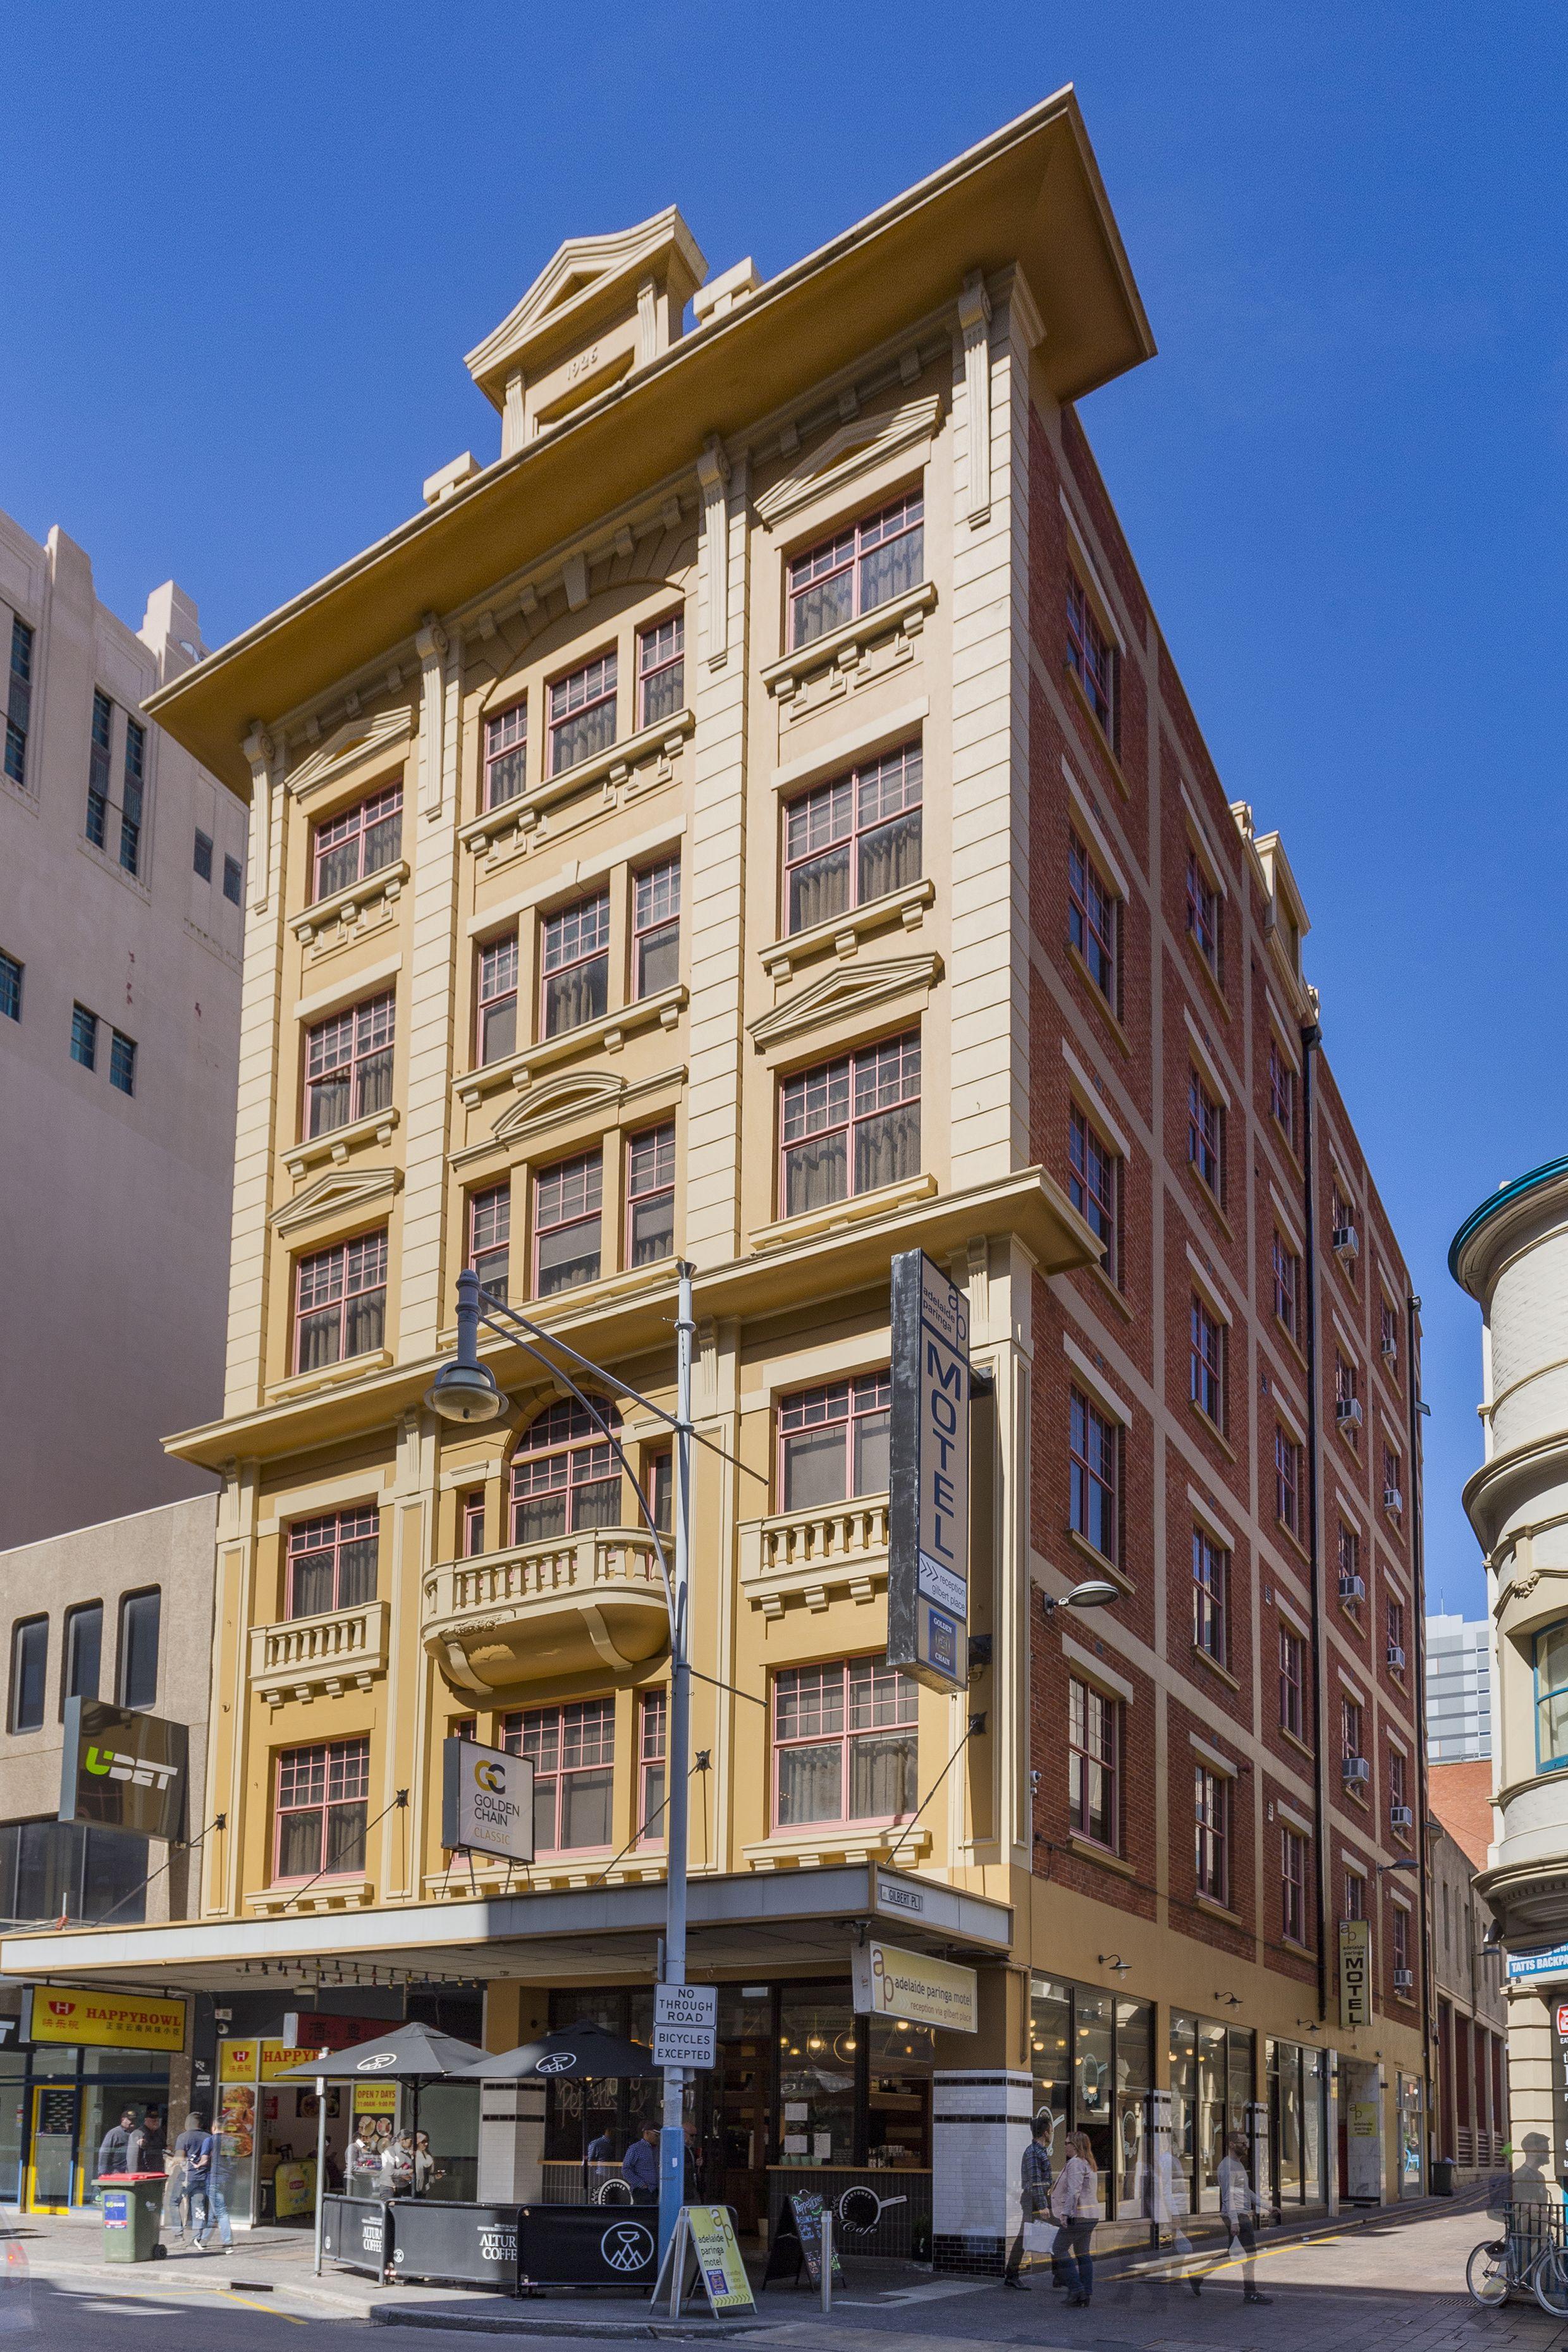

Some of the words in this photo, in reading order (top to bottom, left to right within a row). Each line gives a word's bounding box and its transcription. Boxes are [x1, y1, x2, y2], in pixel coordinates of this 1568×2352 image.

[924, 1287, 955, 1324] adelaide
[924, 1299, 952, 1333] paringa
[928, 1340, 960, 1559] MOTEL
[940, 1575, 965, 1597] reception
[932, 1584, 949, 1602] gilbert
[950, 1596, 965, 1612] place
[933, 1617, 952, 1634] GOLDEN
[935, 1652, 950, 1666] CHAIN
[86, 1746, 178, 1790] UBET
[475, 1794, 520, 1817] GOLDEN
[475, 1808, 508, 1827] CHAIN
[474, 1827, 510, 1845] CLASSIC
[889, 1889, 909, 1905] GILBERT
[911, 1896, 918, 1908] PL
[1512, 1960, 1535, 1973] TATTS
[678, 1988, 694, 1998] NO
[895, 1976, 925, 1995] adelaide
[927, 1987, 952, 2003] paringa
[953, 1993, 972, 2006] motel
[1345, 1957, 1363, 2023] MOTEL
[659, 1999, 713, 2011] THROUGH
[910, 2002, 934, 2014] reception
[943, 2009, 959, 2019] gilbert
[960, 2012, 972, 2023] place
[87, 2007, 181, 2026] HAPPYBOWL
[668, 2012, 703, 2022] ROAD
[659, 2033, 710, 2045] BICYCLES
[658, 2049, 711, 2060] EXCEPTED
[381, 2090, 395, 2098] DAYS
[843, 2191, 871, 2214] PEPPERTONES
[840, 2219, 878, 2236] Cafe
[479, 2233, 517, 2248] ALTUR
[698, 2234, 724, 2243] adelaide
[482, 2246, 517, 2260] COFFE
[701, 2246, 725, 2258] paringa
[704, 2257, 723, 2267] motel
